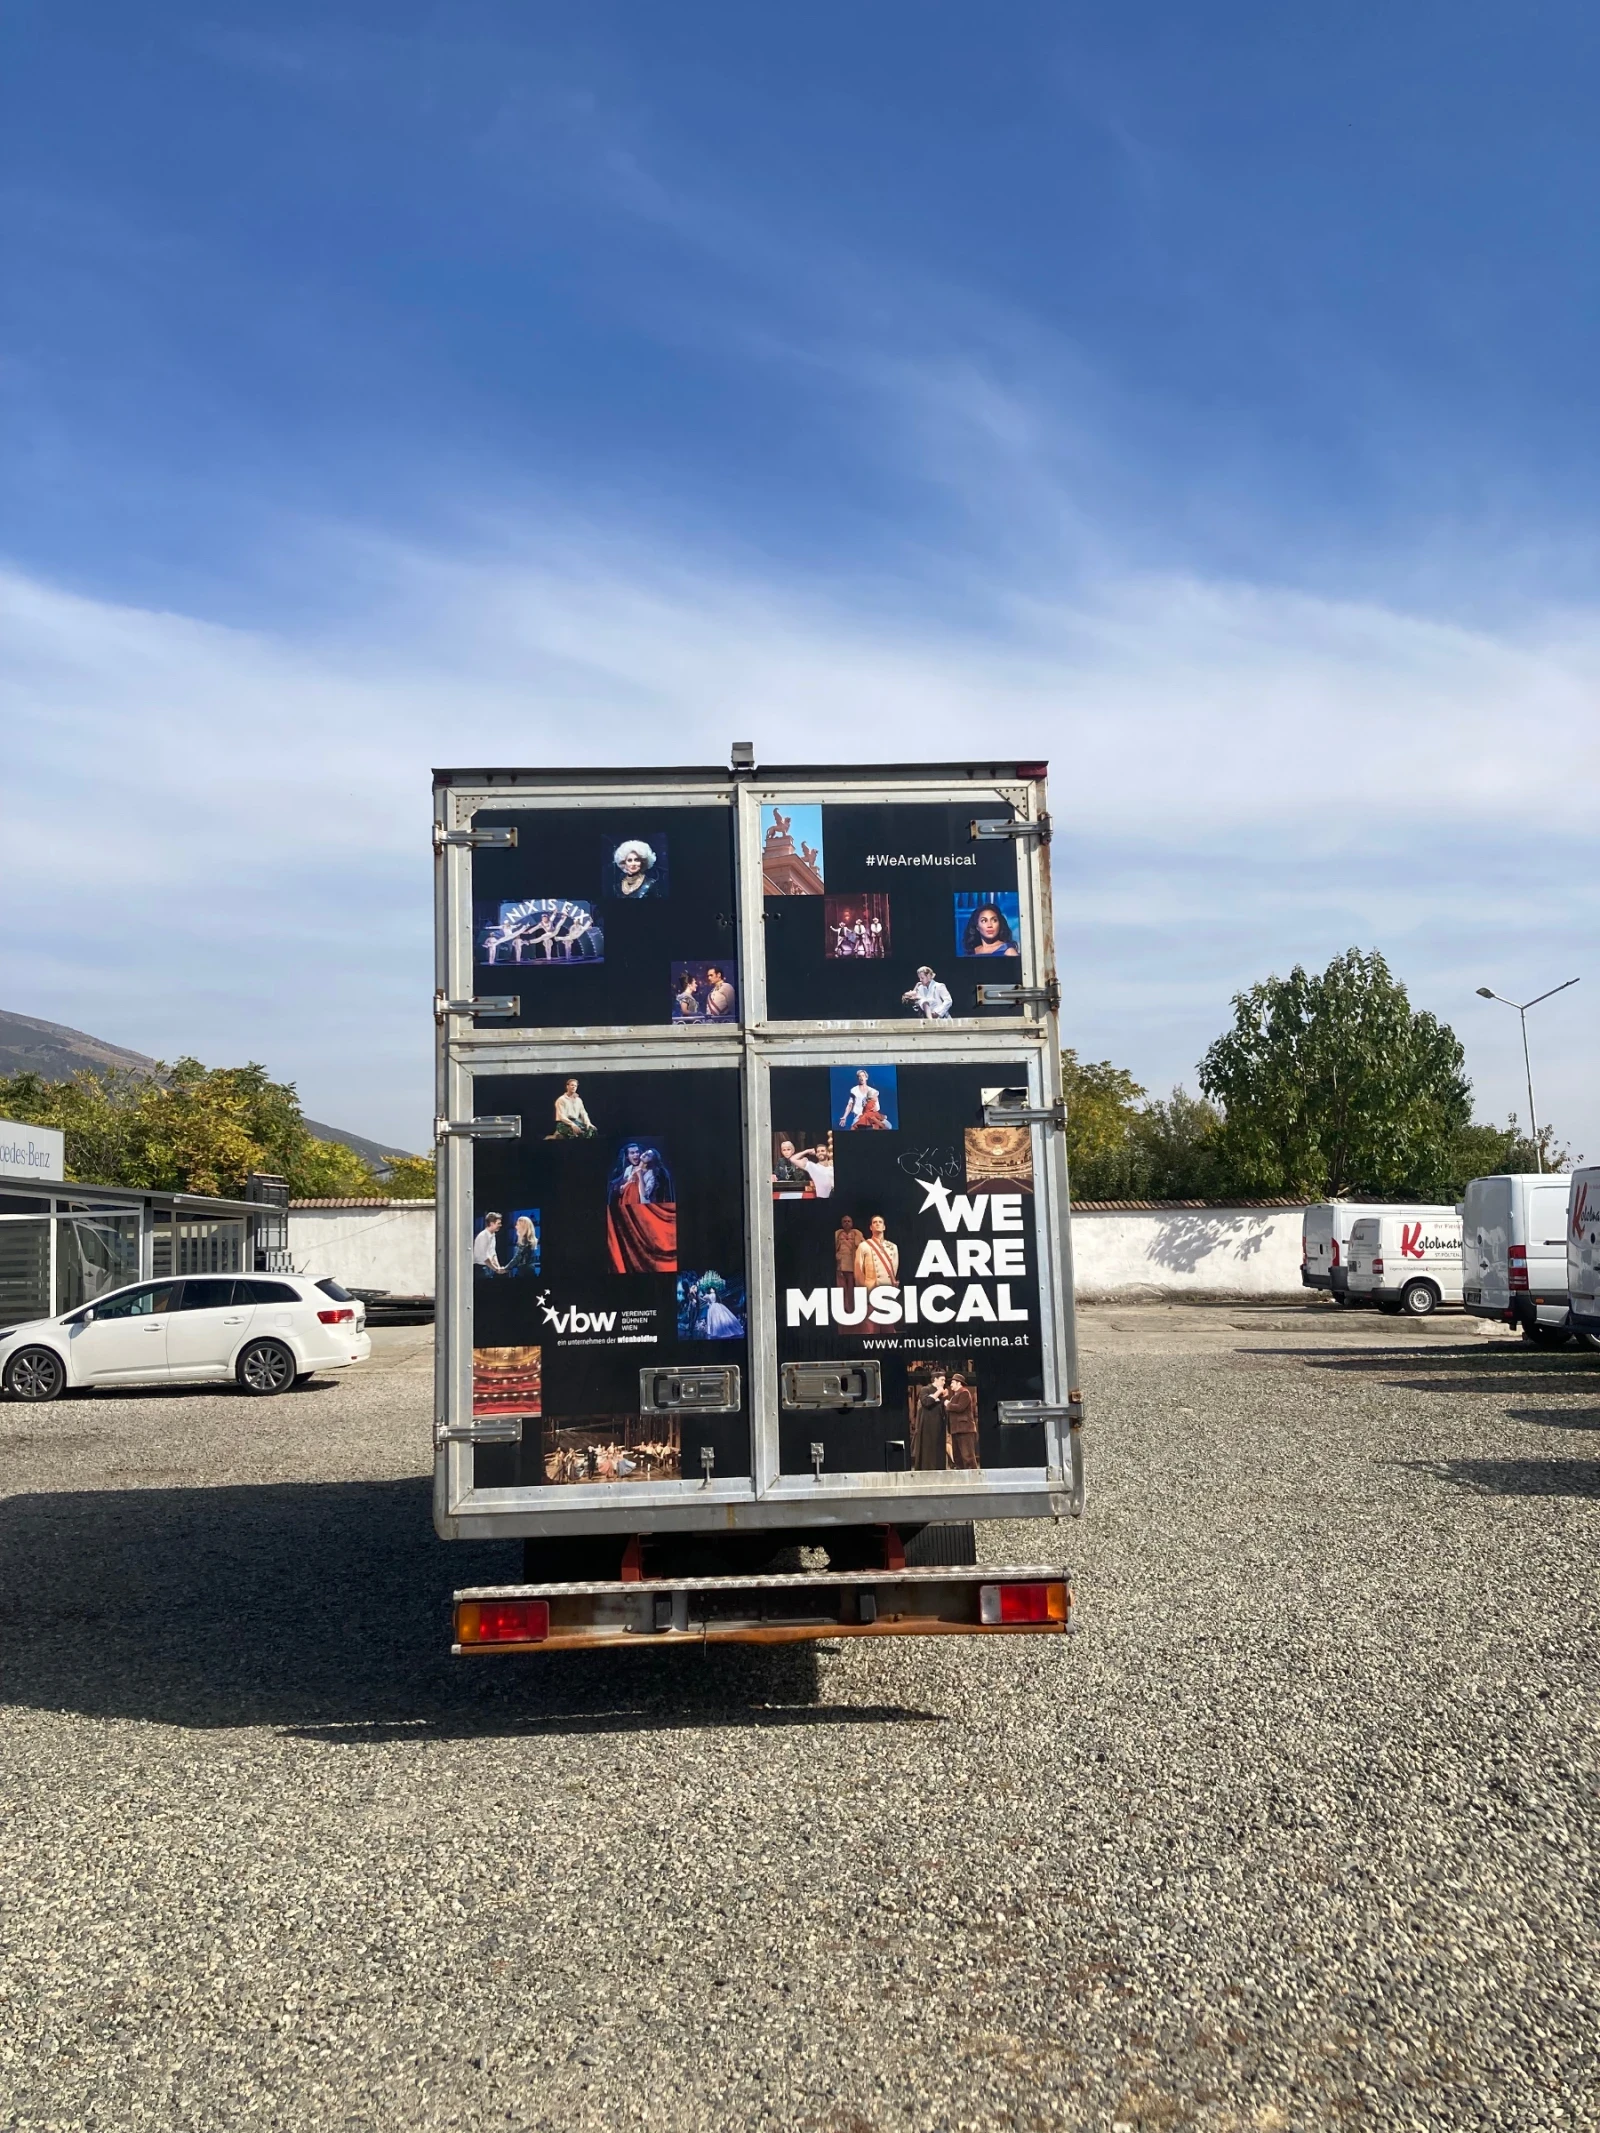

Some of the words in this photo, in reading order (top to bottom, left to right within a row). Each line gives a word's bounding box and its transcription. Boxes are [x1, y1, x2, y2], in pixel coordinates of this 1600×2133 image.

[866, 853, 977, 866] #WeAreMusical
[506, 900, 539, 923] NIX
[541, 899, 557, 911] IS
[562, 901, 590, 924] FIX
[933, 1194, 1024, 1233] WE
[915, 1238, 1027, 1278] ARE
[786, 1283, 1029, 1327] MUSICAL
[552, 1305, 617, 1334] vbw
[568, 1337, 605, 1346] unternehmen
[863, 1334, 1029, 1349] www.musicalvienna.at
